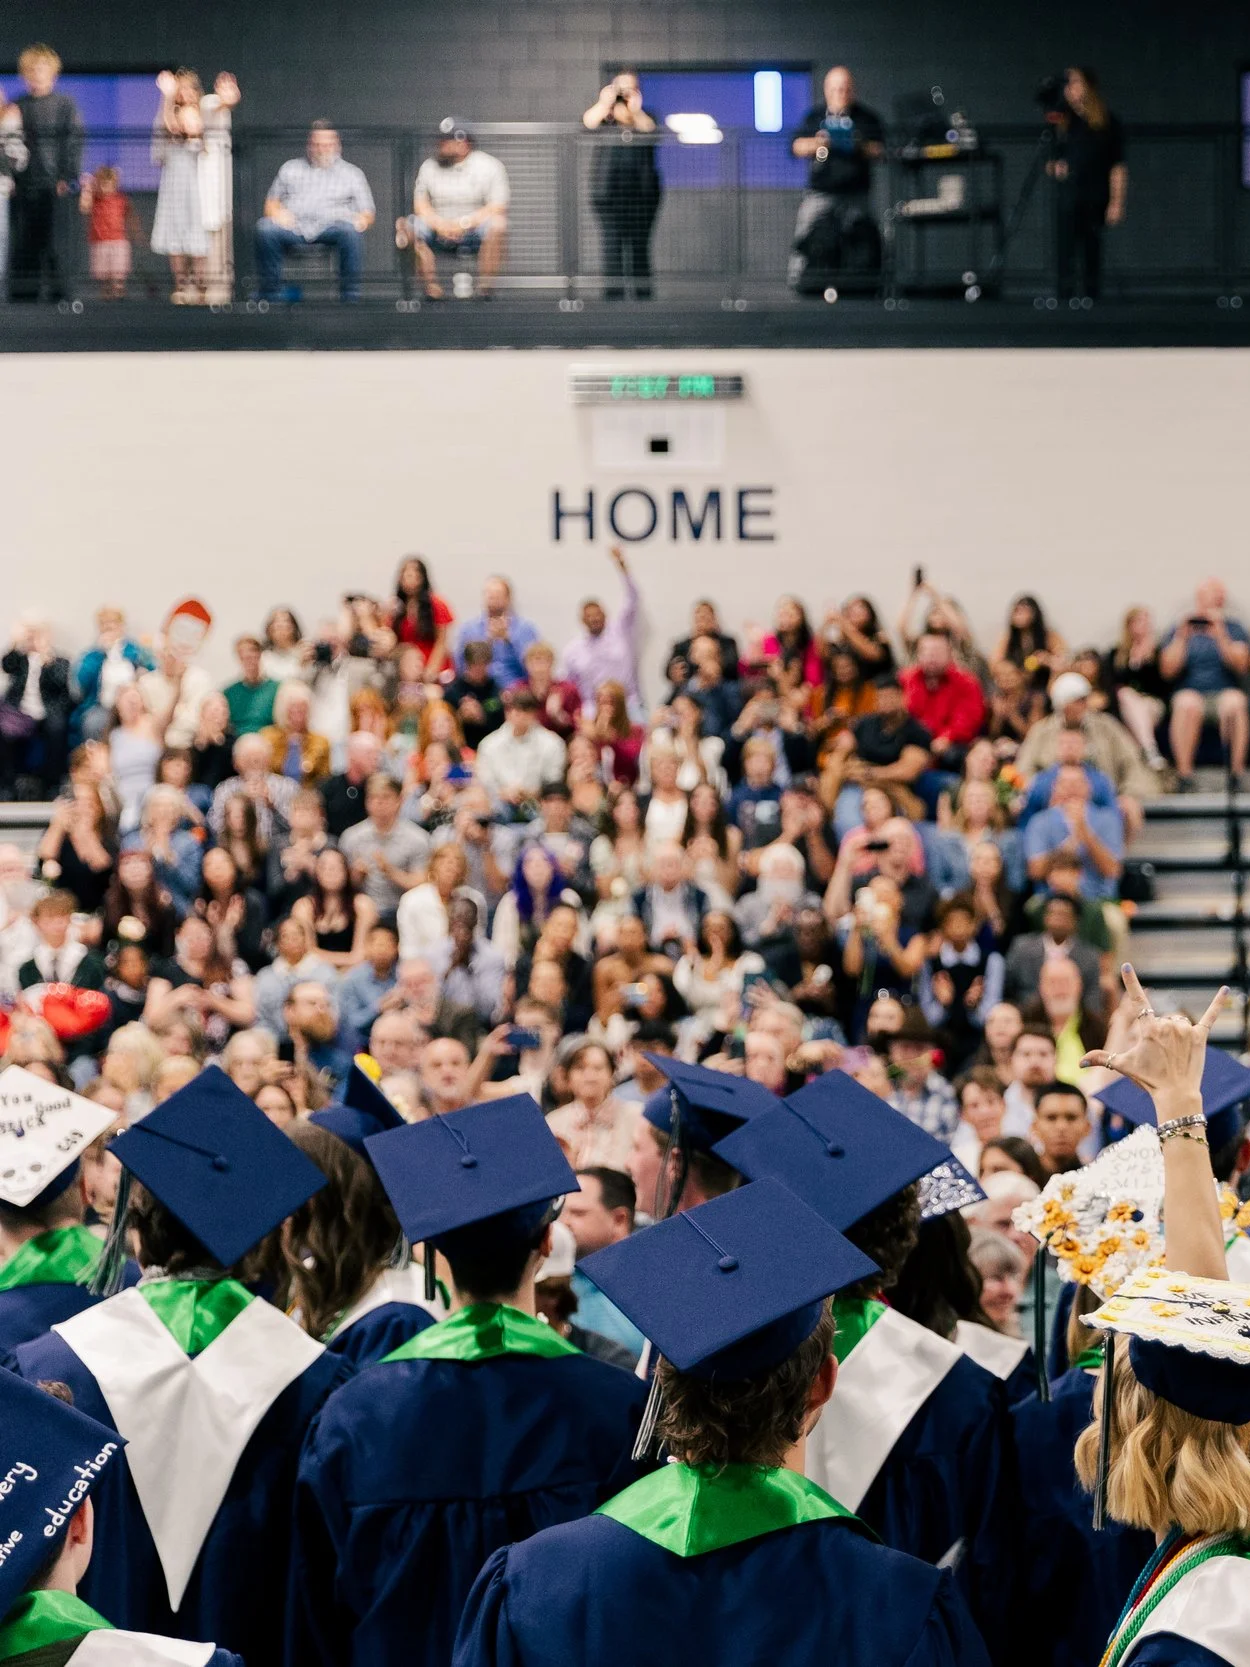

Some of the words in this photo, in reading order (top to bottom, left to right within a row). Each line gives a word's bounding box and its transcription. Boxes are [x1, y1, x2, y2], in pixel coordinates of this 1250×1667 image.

[552, 488, 776, 543] HOME
[1173, 1291, 1214, 1300] WE
[43, 1442, 118, 1537] education
